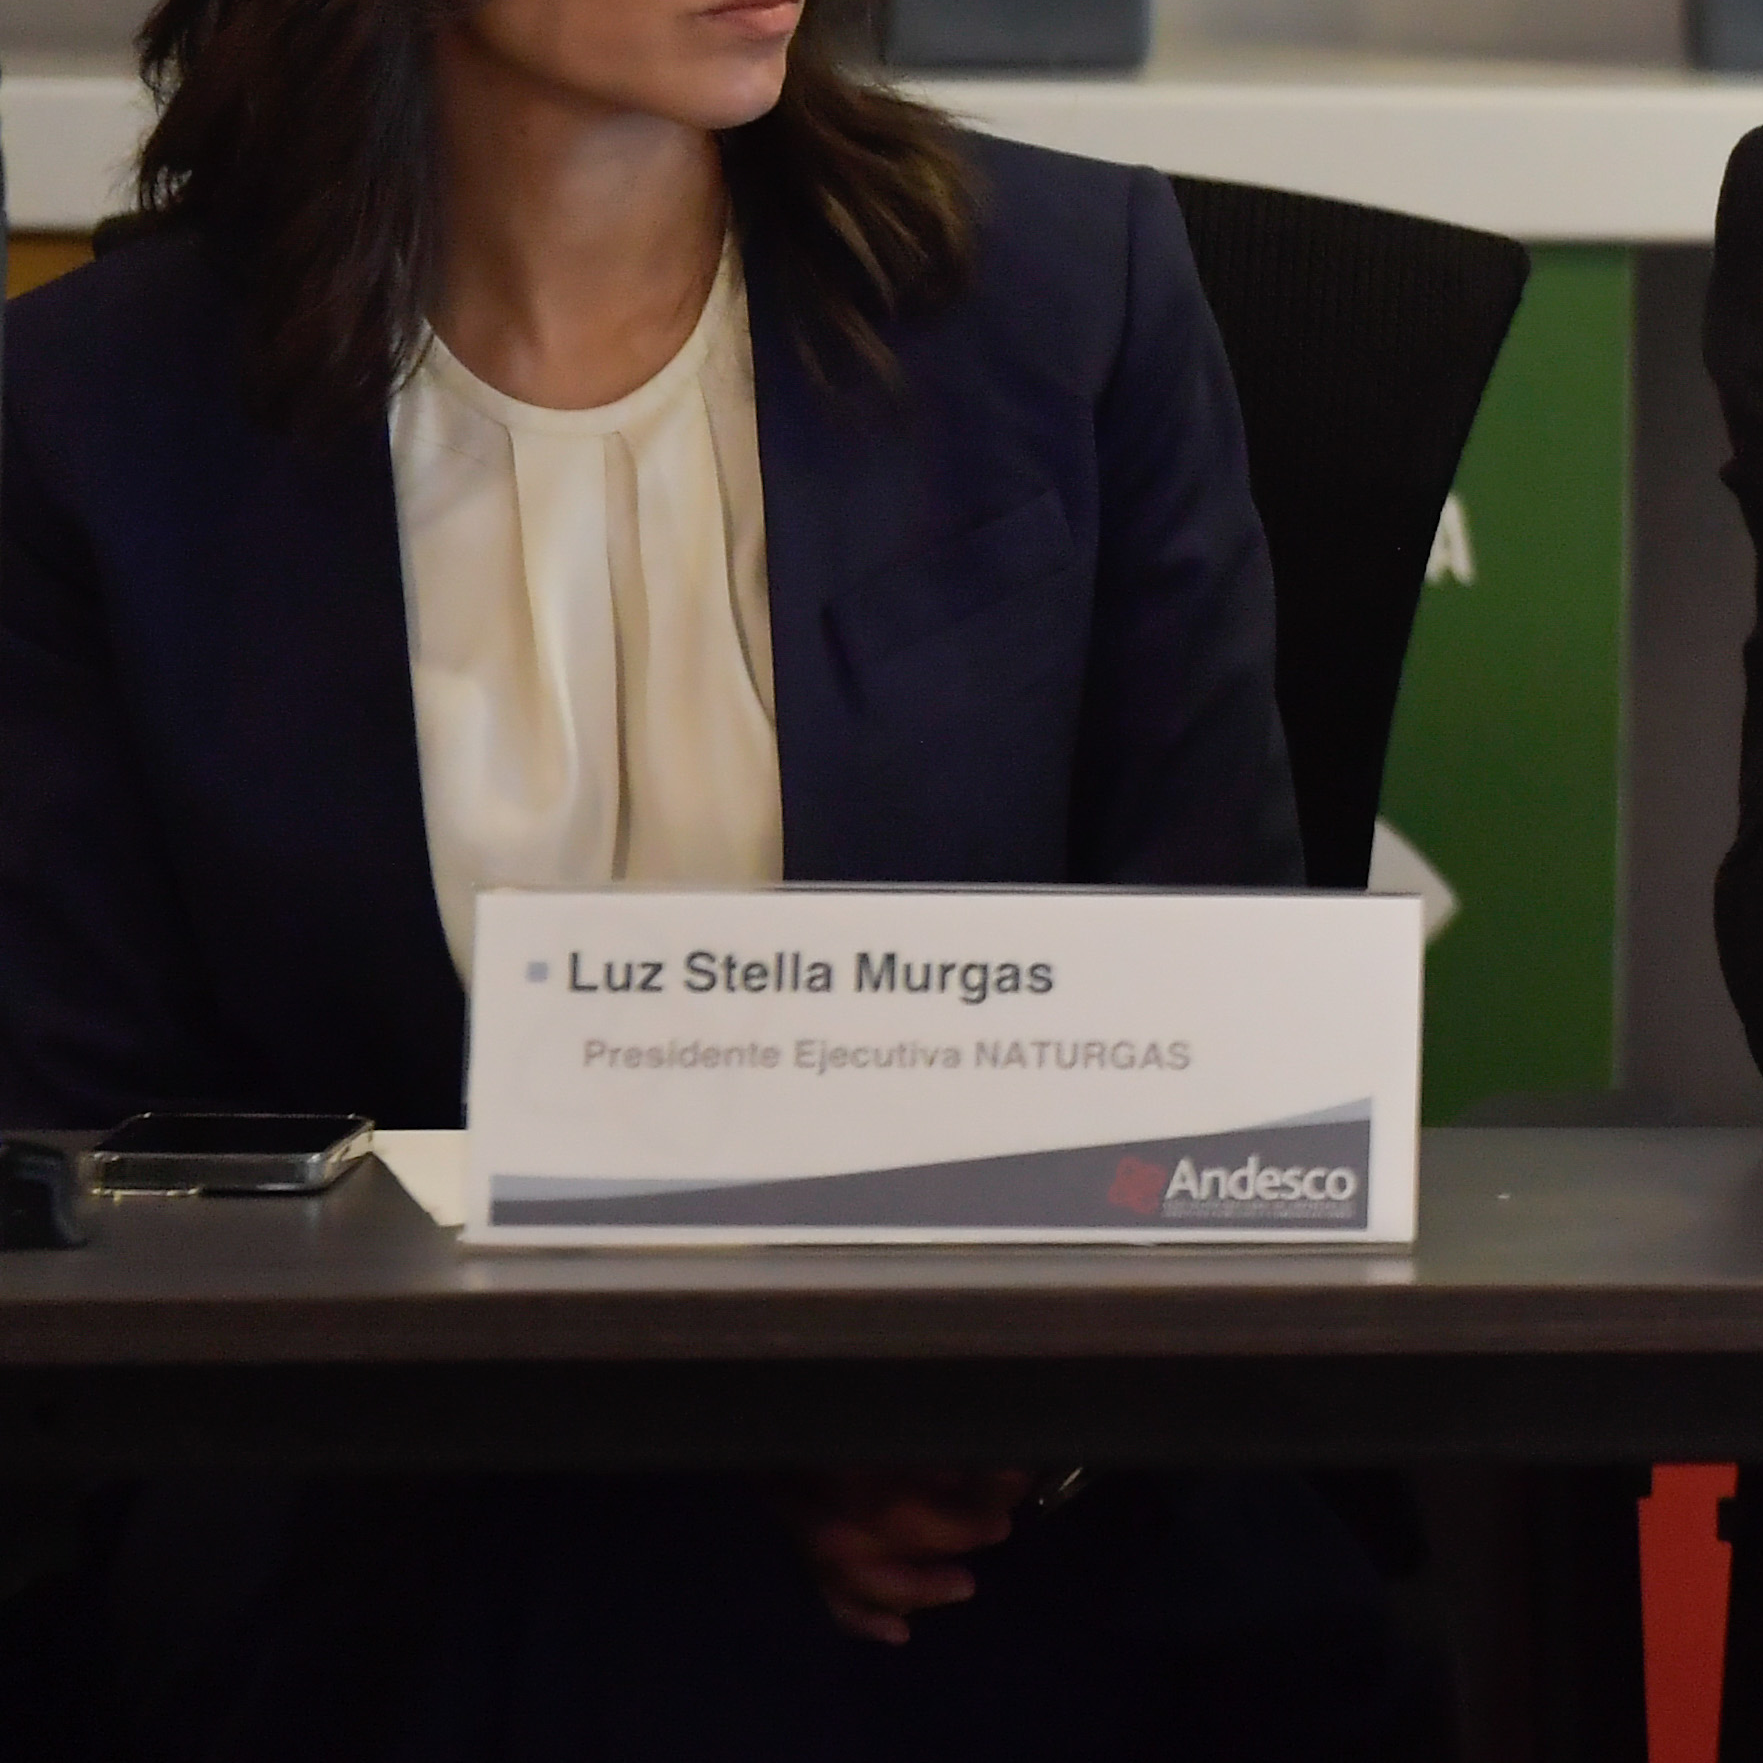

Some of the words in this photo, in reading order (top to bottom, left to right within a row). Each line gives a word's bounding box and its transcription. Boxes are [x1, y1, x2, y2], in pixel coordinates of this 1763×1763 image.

[568, 950, 664, 994] Luz
[683, 949, 833, 994] Stella
[854, 950, 1055, 1006] Murgas
[583, 1037, 781, 1071] Presidente
[792, 1037, 962, 1077] Ejecutiva
[973, 1039, 1192, 1072] NATURGAS
[1164, 1154, 1358, 1201] Andesco
